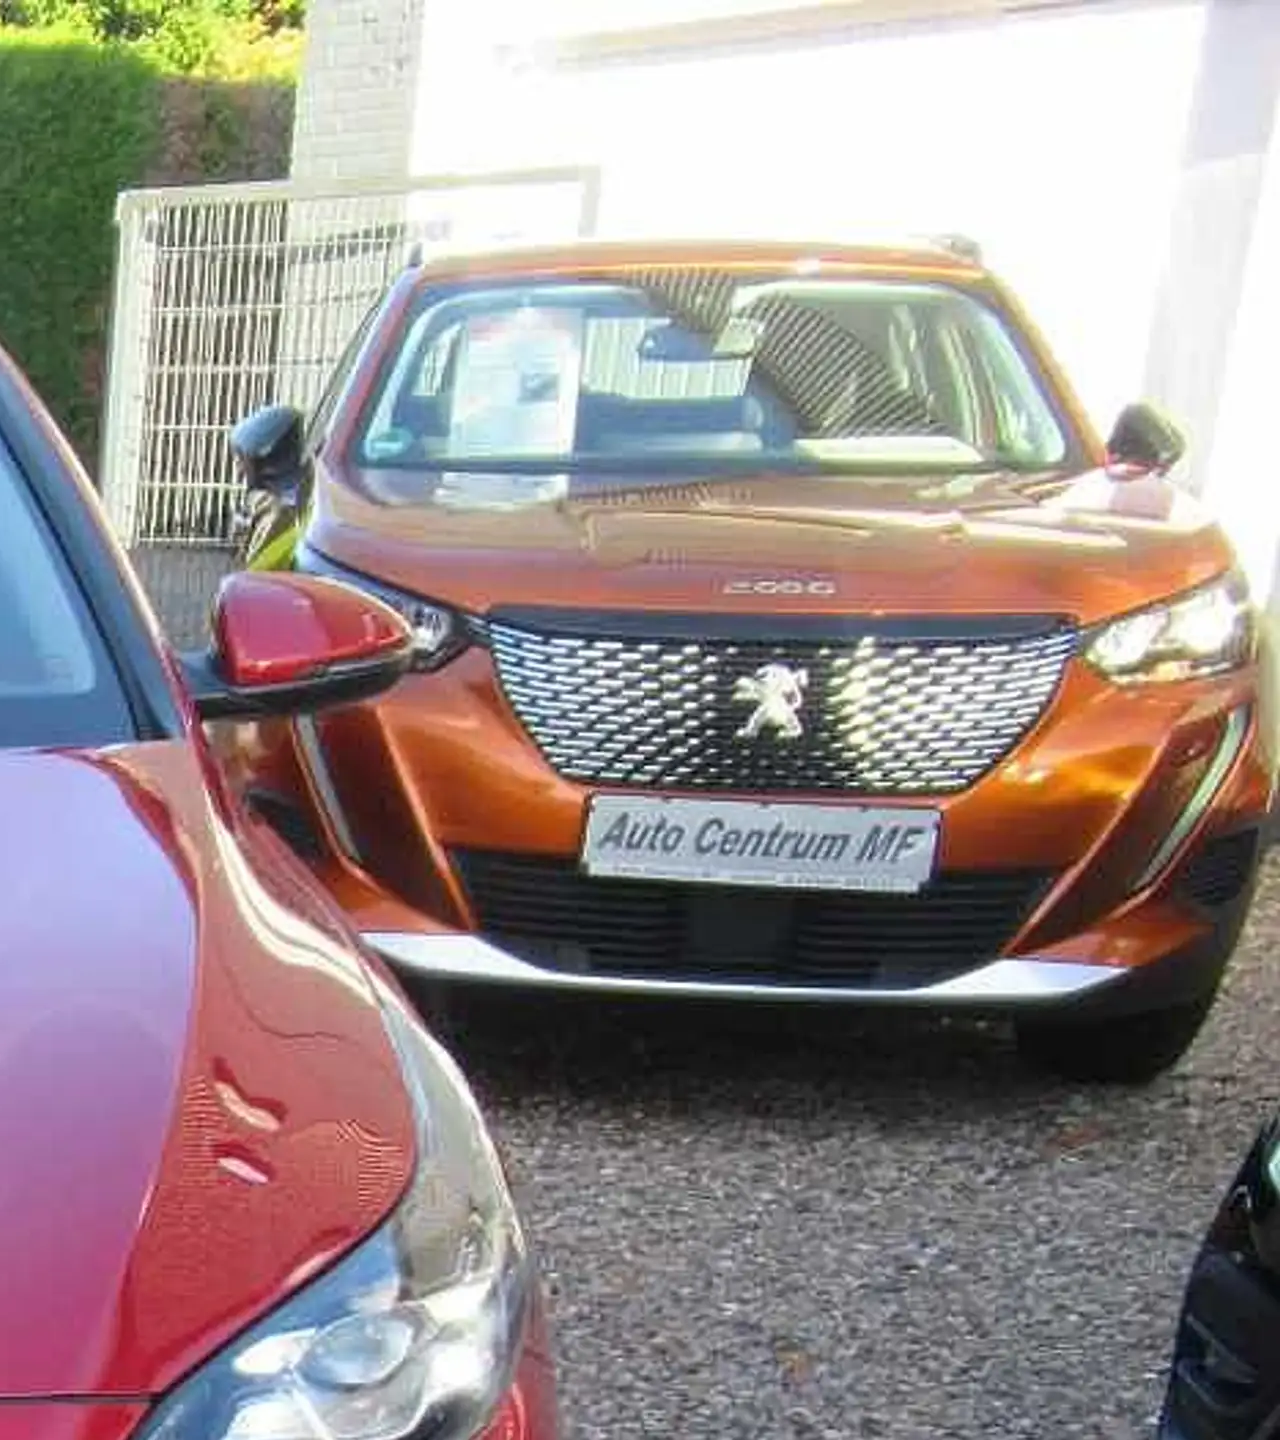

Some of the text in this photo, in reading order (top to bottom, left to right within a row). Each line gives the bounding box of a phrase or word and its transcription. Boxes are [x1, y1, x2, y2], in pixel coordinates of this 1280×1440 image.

[598, 812, 925, 863] Auto Centrum MF
